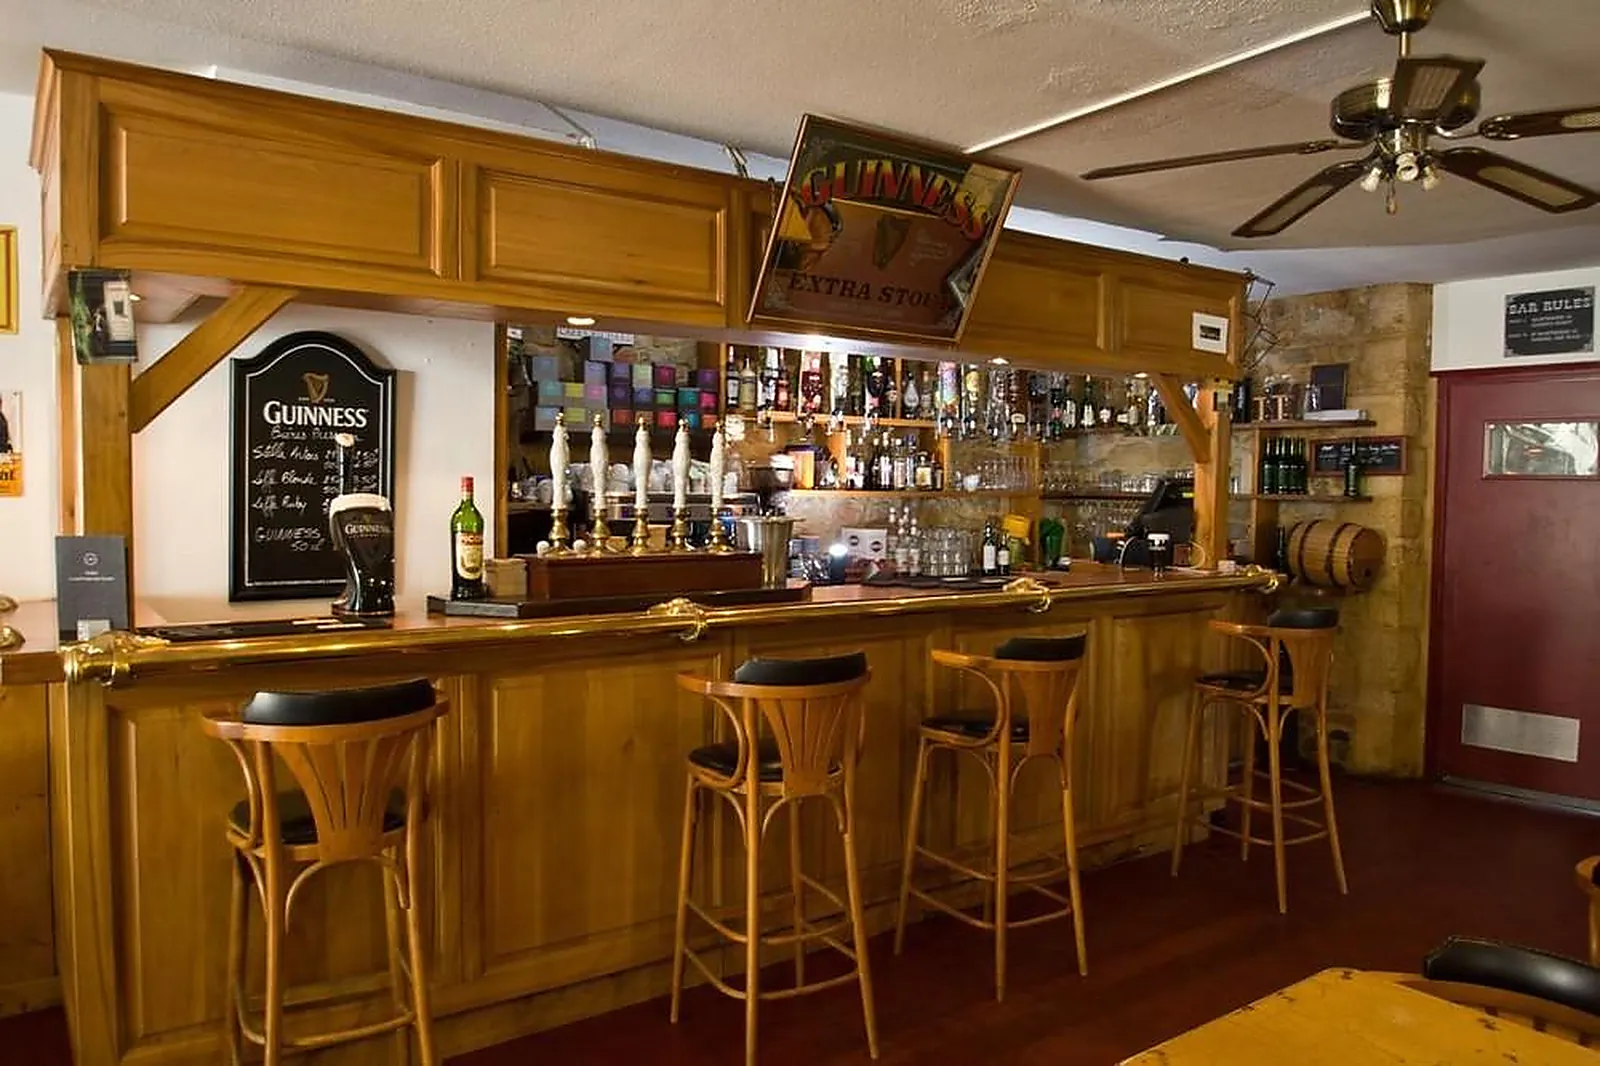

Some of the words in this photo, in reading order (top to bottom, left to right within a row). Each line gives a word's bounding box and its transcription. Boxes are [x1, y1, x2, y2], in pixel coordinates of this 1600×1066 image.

[800, 157, 992, 241] GUINNESS
[788, 272, 871, 300] EXTRA
[1508, 302, 1539, 315] BAR
[1542, 297, 1591, 312] RULES
[263, 400, 368, 428] GUINNESS
[255, 526, 321, 543] GUINNESS
